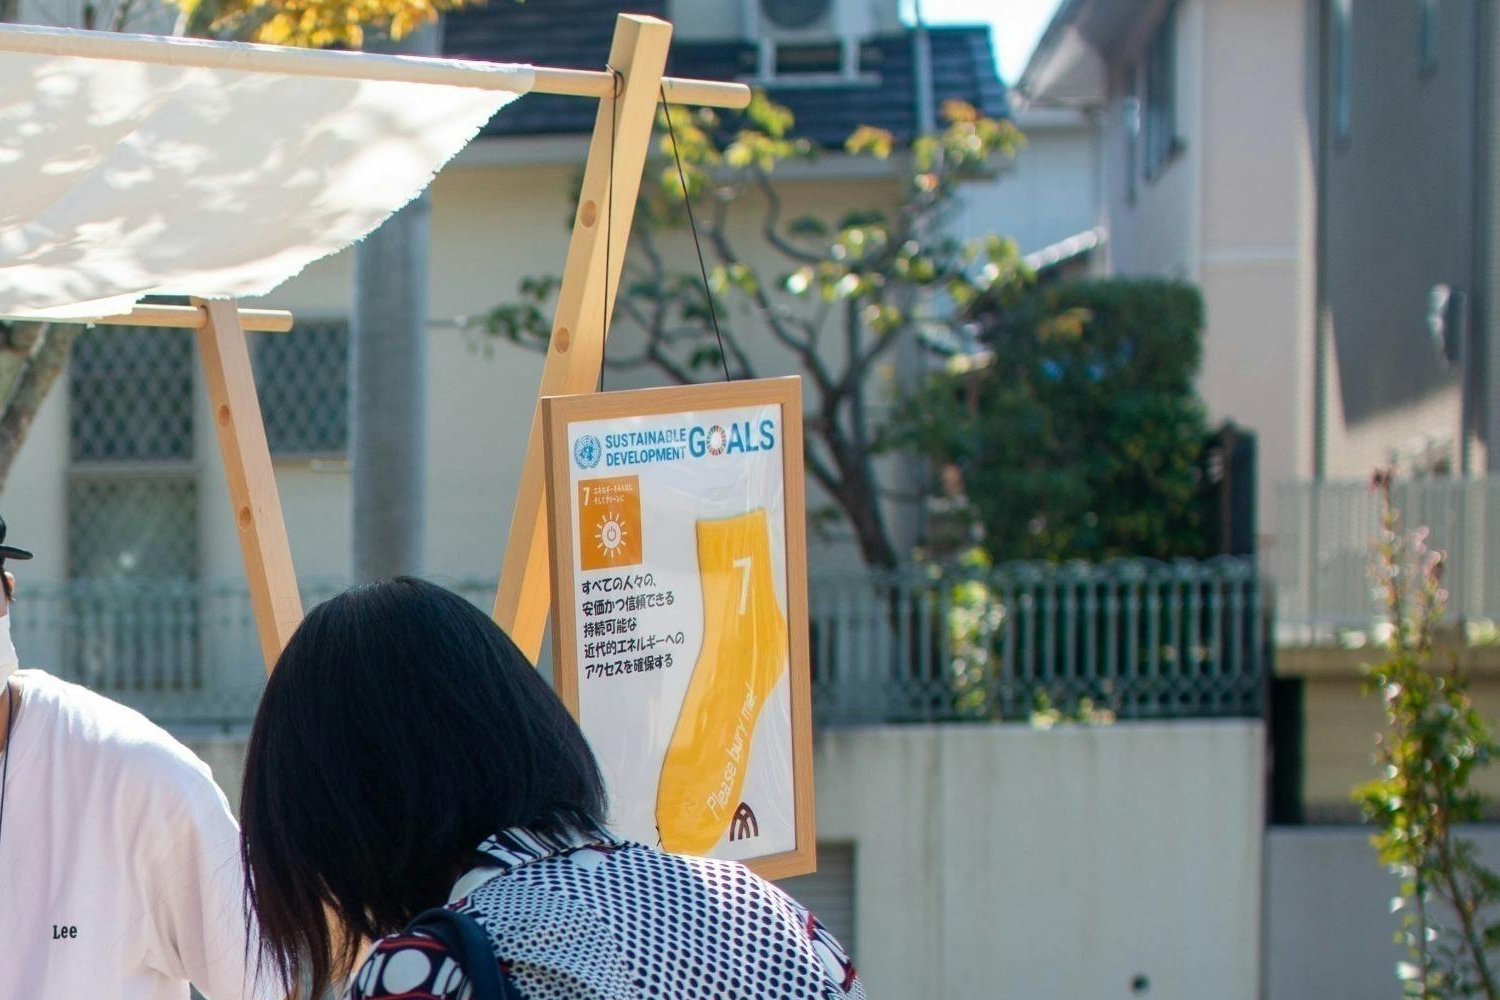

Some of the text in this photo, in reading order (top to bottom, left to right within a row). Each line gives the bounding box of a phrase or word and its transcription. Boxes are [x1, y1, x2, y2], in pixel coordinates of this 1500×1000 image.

[605, 419, 775, 459] SUSTAINABLE GOALS
[606, 447, 687, 468] DEVELOPMENT
[583, 486, 590, 506] 7
[732, 556, 753, 616] 7
[582, 590, 675, 617] 安価かつ信頼できる
[583, 617, 637, 639] 持続可能な
[584, 631, 685, 660] 近代的エネルギーへの
[585, 653, 674, 680] アクセスを確保する
[706, 761, 738, 822] Please
[726, 717, 749, 764] bury
[52, 924, 78, 940] Lee
